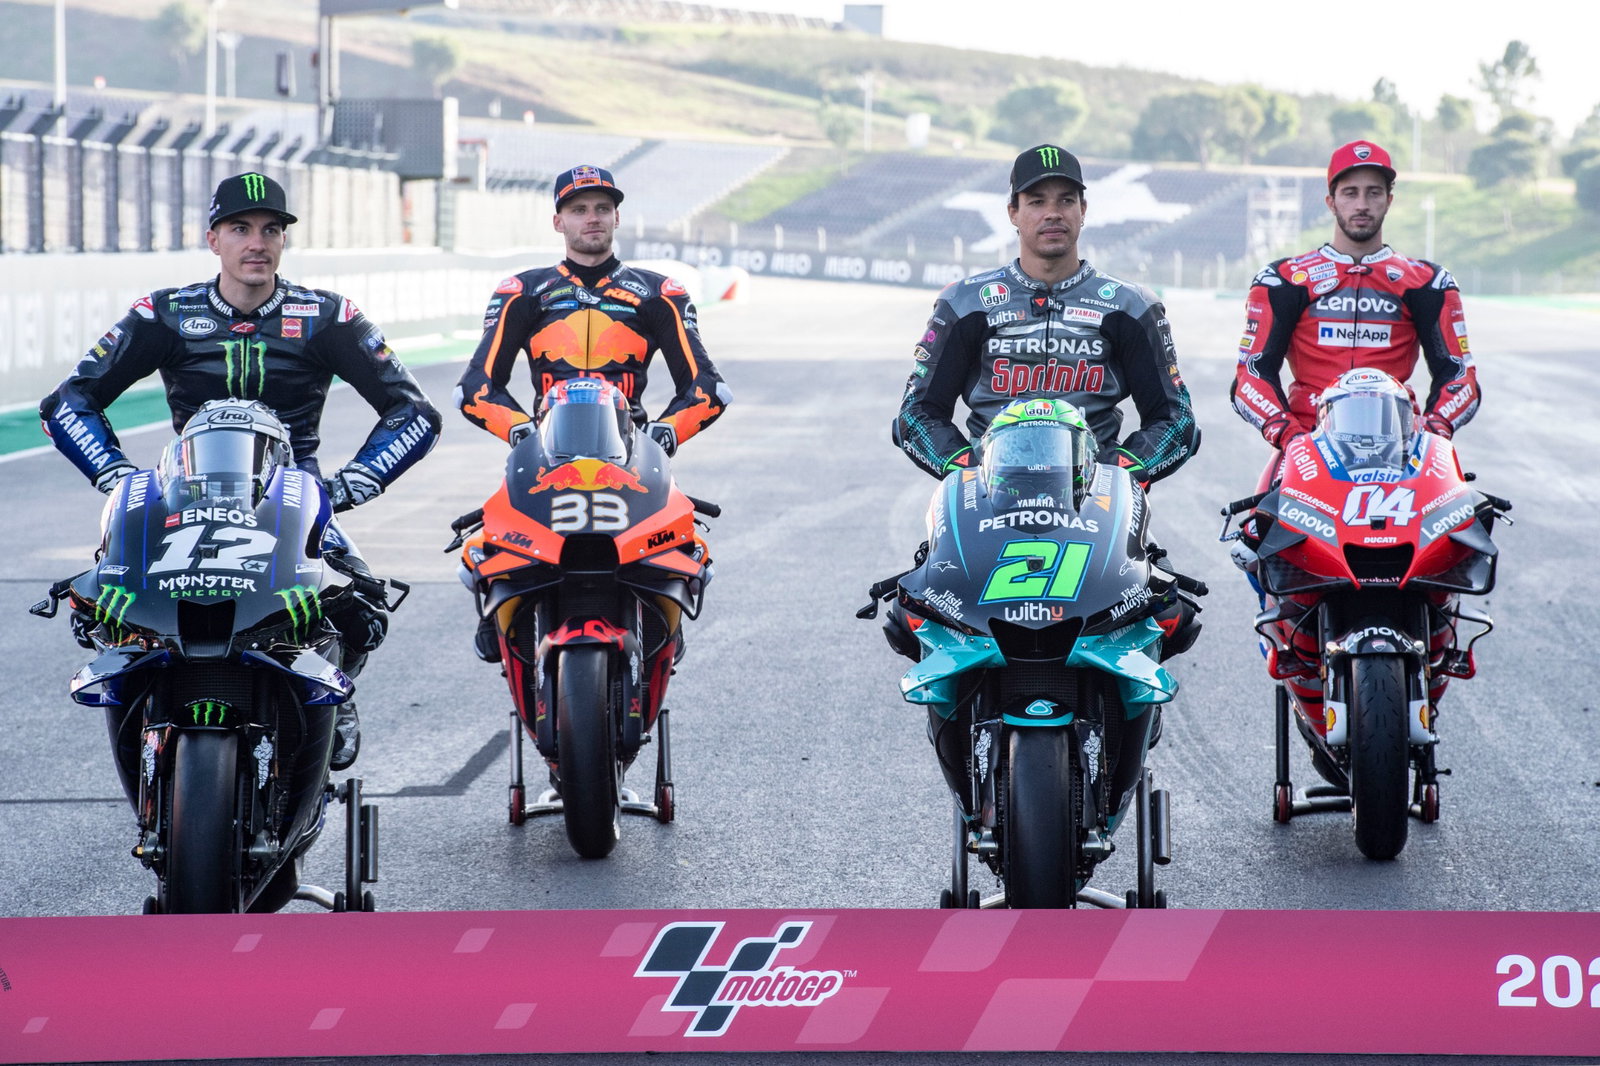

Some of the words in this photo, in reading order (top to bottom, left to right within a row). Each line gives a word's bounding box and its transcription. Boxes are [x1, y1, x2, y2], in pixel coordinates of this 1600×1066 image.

[208, 288, 233, 317] YAMAHA
[258, 290, 285, 317] YAMAHA
[603, 288, 641, 306] KTM
[1080, 297, 1120, 310] PETRONAS
[1316, 296, 1397, 313] Lenovo
[184, 319, 213, 330] Arai
[1336, 328, 1388, 341] NetApp
[988, 337, 1103, 356] PETRONAS
[991, 358, 1105, 397] Sprinta
[1240, 382, 1281, 417] DUCATI
[1438, 384, 1473, 418] DUCATI
[215, 409, 249, 421] Arai
[1018, 420, 1060, 428] PETRONAS
[55, 401, 111, 469] YAMAHA
[371, 414, 431, 474] YAMAHA
[903, 440, 942, 476] PETRONAS
[1148, 445, 1188, 476] PETRONAS
[282, 470, 303, 508] YAMAHA
[1353, 470, 1400, 483] valsir
[126, 471, 151, 512] YAMAHA
[1017, 499, 1054, 508] YAMAHA
[1281, 486, 1340, 516] FRECCIAROSSA
[181, 507, 258, 527] ENEOS
[551, 492, 630, 532] 33
[1278, 501, 1335, 537] Lenovo
[1342, 485, 1418, 526] 04
[978, 509, 1100, 533] PETRONAS
[1421, 504, 1475, 540] Lenovo
[147, 525, 278, 574] 12
[502, 531, 534, 549] KTM
[647, 530, 675, 549] KTM
[1364, 536, 1397, 544] DUCATI
[158, 573, 257, 592] MONSTER
[978, 539, 1095, 604] 21
[170, 590, 243, 599] ENERGY
[921, 587, 964, 621] Malaysia
[942, 590, 964, 608] Visit
[1109, 587, 1153, 621] Malaysia
[1121, 583, 1141, 600] Visit
[1343, 626, 1412, 650] Lenovo
[1496, 954, 1600, 1008] 20
